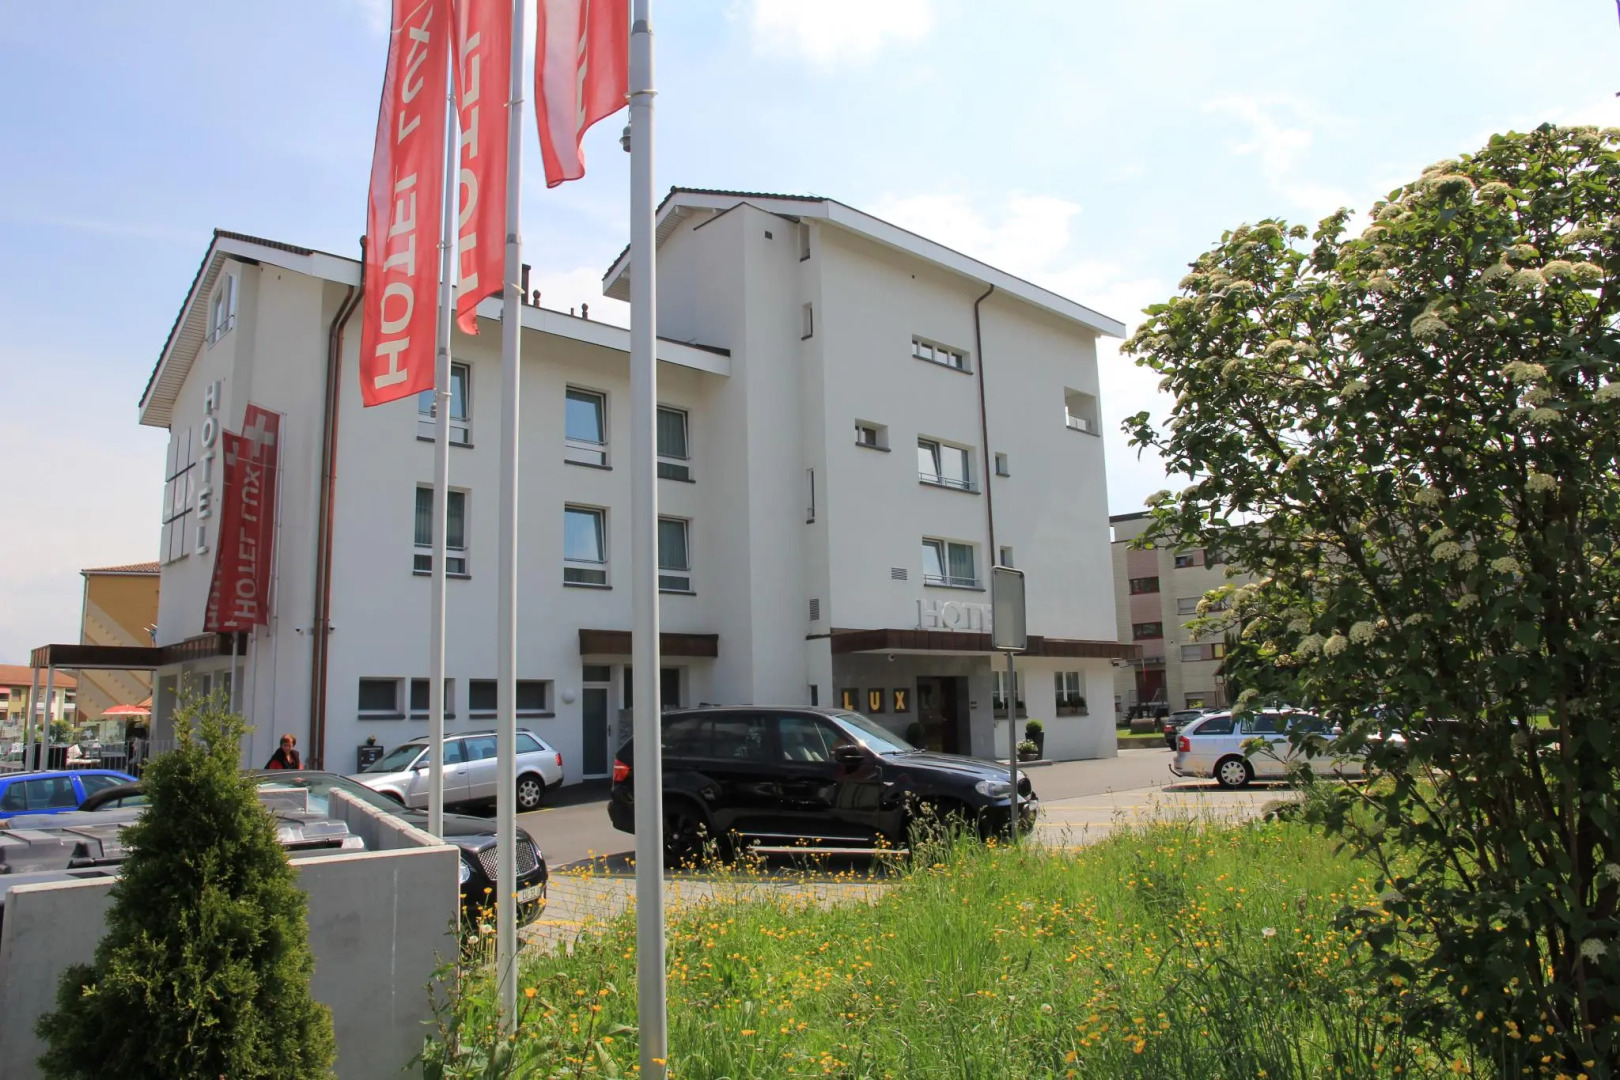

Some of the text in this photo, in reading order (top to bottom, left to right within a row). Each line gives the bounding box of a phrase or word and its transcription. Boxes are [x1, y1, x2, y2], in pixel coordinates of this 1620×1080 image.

[195, 379, 221, 555] HOTEL
[915, 599, 992, 631] HOTE
[842, 690, 905, 710] LUX
